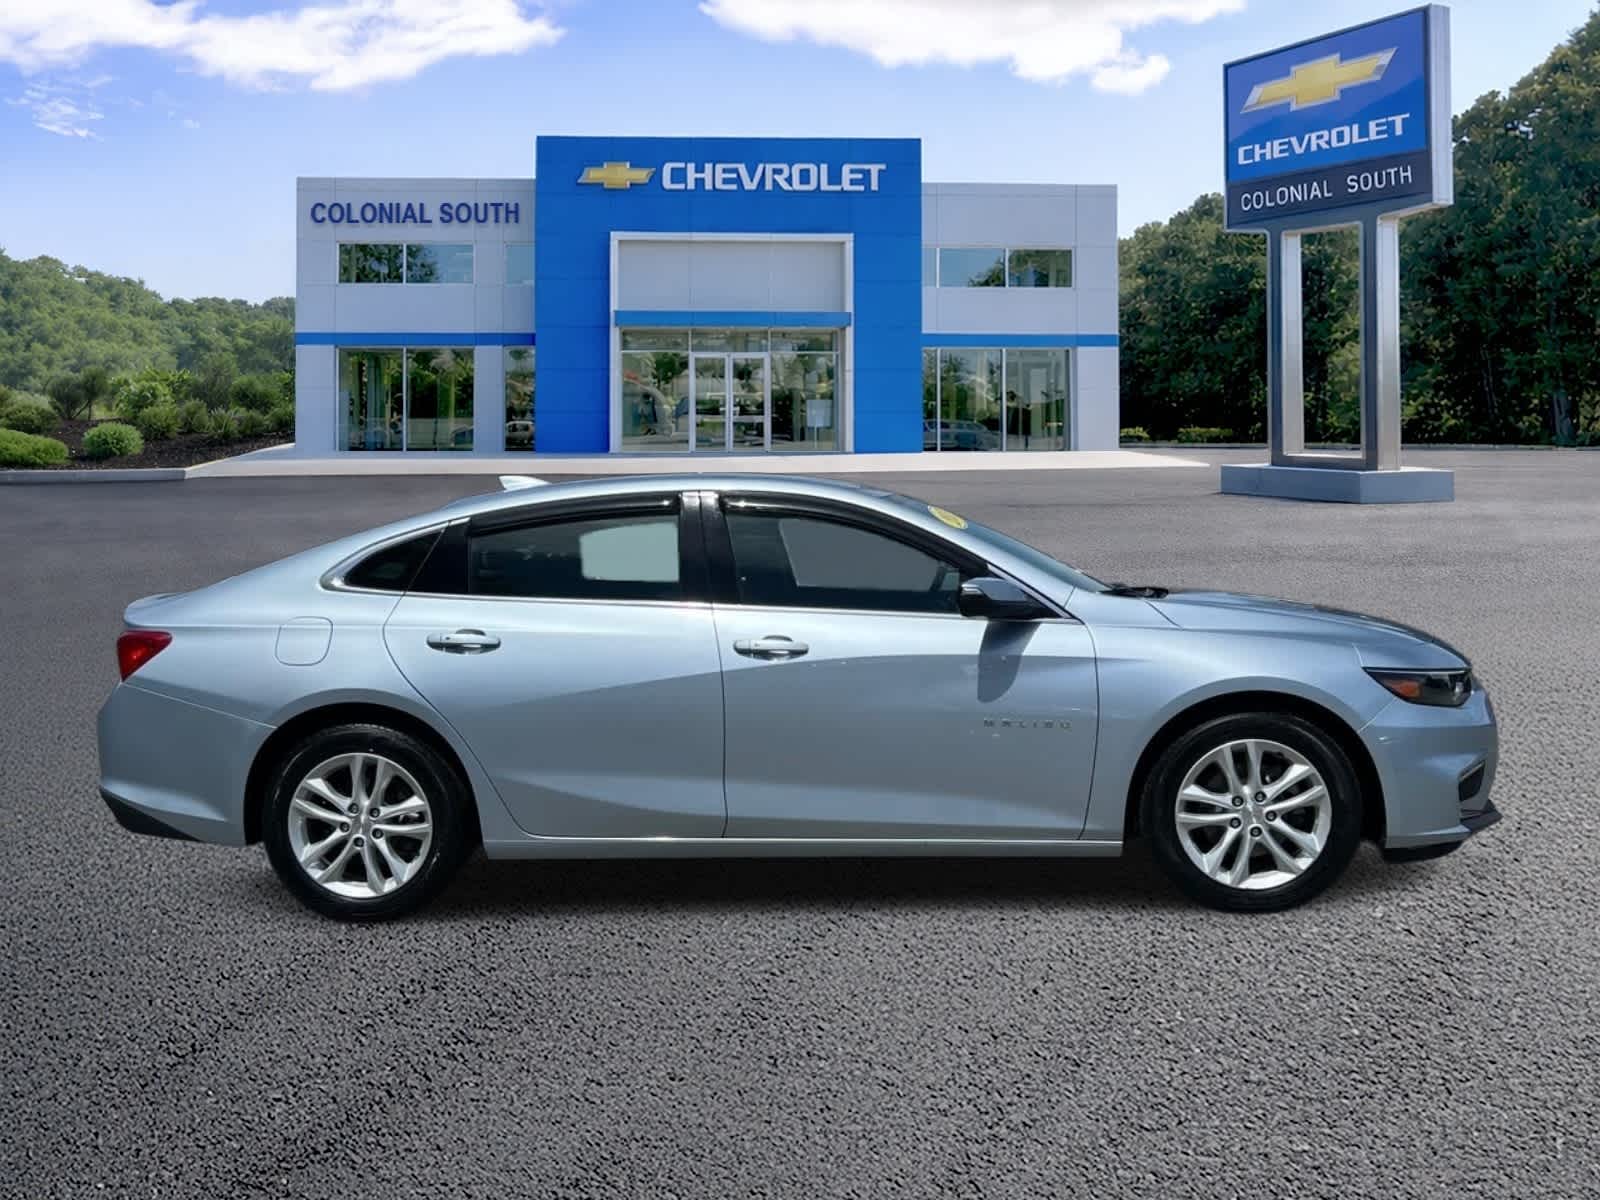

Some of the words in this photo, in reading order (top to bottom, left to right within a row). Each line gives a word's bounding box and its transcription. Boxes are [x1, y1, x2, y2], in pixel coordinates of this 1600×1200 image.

[1237, 113, 1411, 165] CHEVROLET
[661, 161, 887, 192] CHEVROLET
[1240, 180, 1333, 212] COLONIAL
[1346, 165, 1413, 193] SOUTH
[310, 202, 433, 225] COLONIAL
[439, 202, 521, 225] SOUTH
